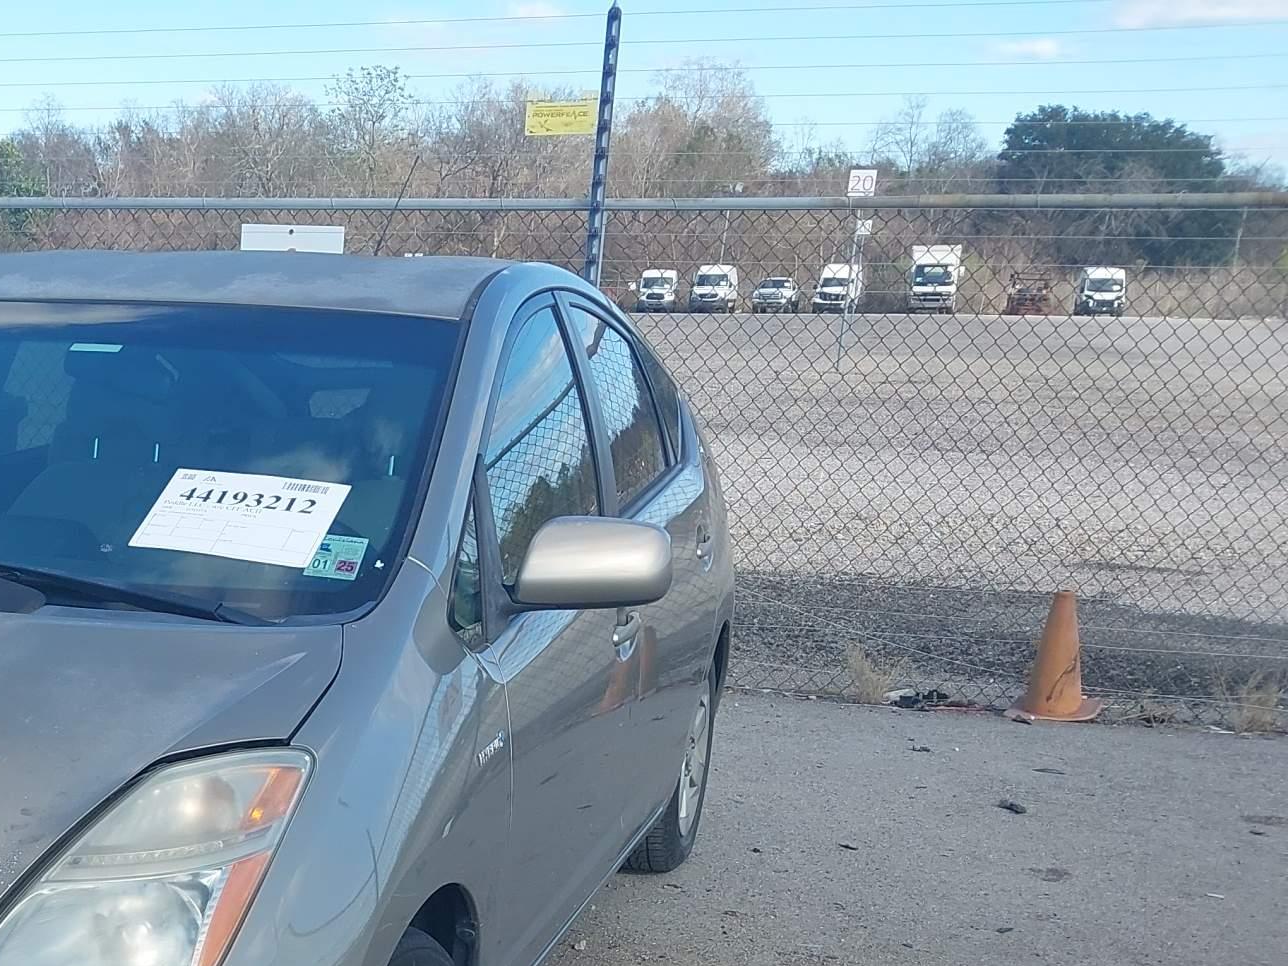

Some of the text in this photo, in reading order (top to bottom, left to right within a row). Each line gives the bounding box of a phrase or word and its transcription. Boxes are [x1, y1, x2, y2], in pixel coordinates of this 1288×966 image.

[850, 175, 874, 191] 20
[179, 487, 317, 514] 44193212
[312, 558, 329, 569] 01
[336, 560, 354, 572] 25
